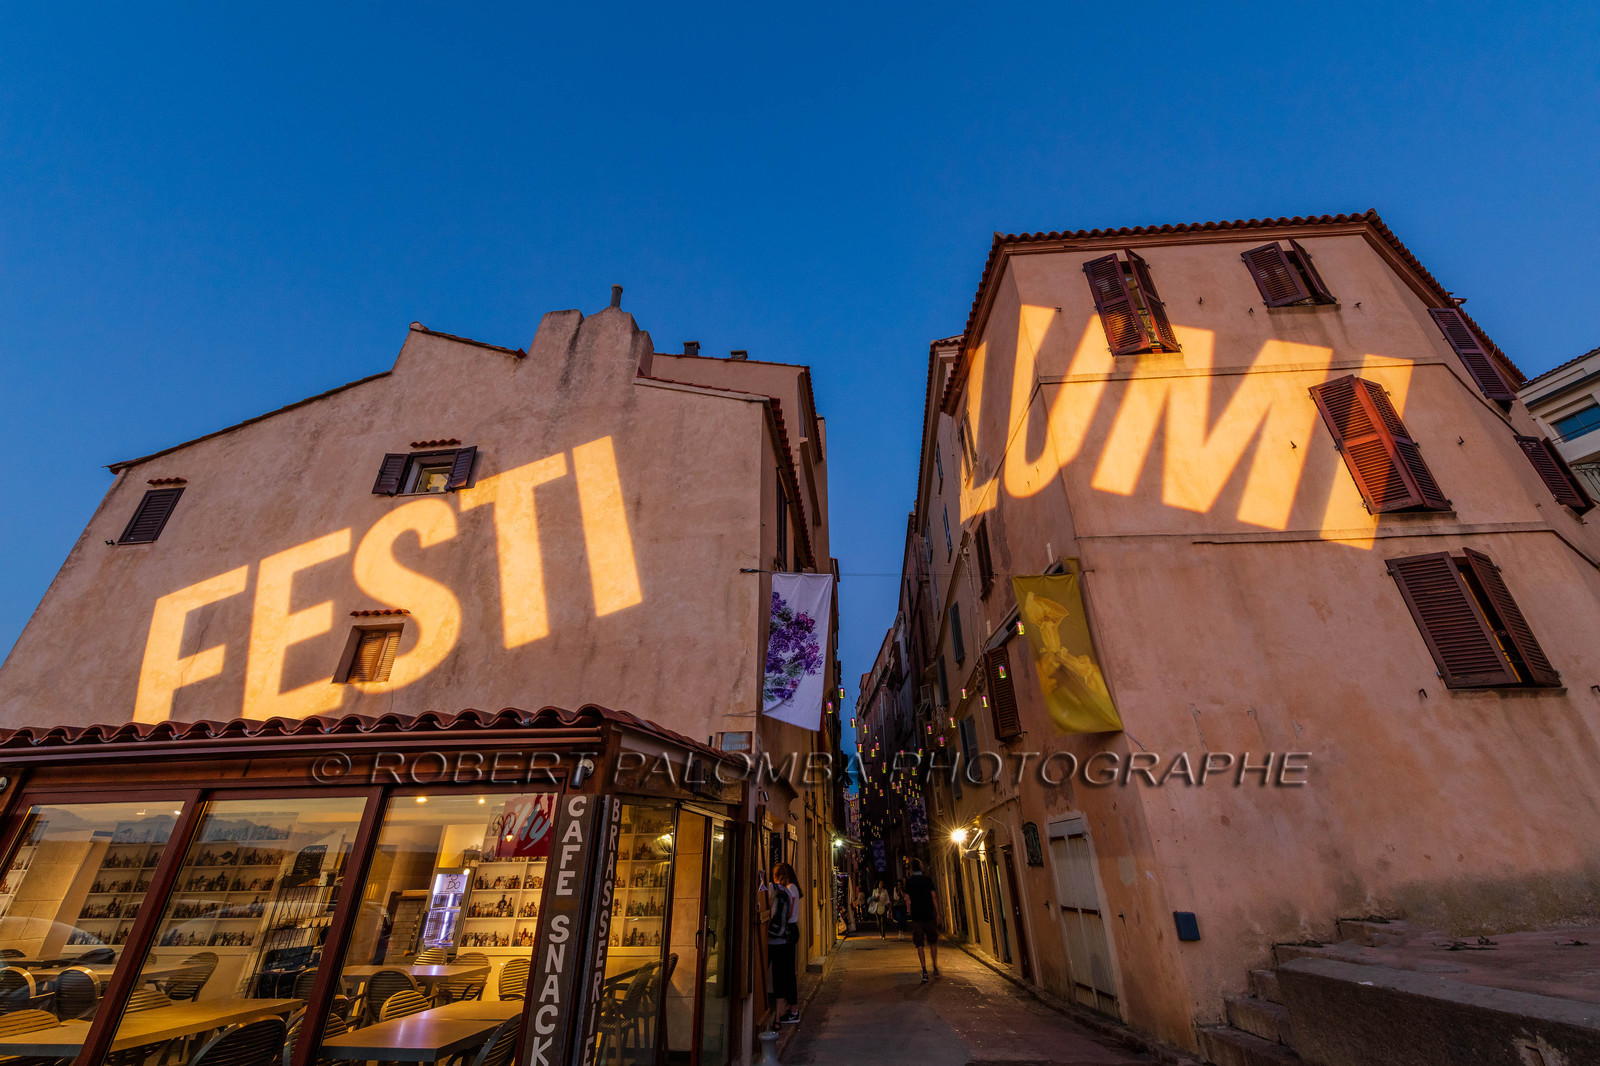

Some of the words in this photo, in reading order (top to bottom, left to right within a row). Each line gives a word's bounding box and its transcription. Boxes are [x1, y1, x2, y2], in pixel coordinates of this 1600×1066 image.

[959, 303, 1414, 549] LUMI
[132, 435, 643, 724] FESTI
[555, 796, 587, 895] CAFE
[530, 914, 570, 1066] SNACK
